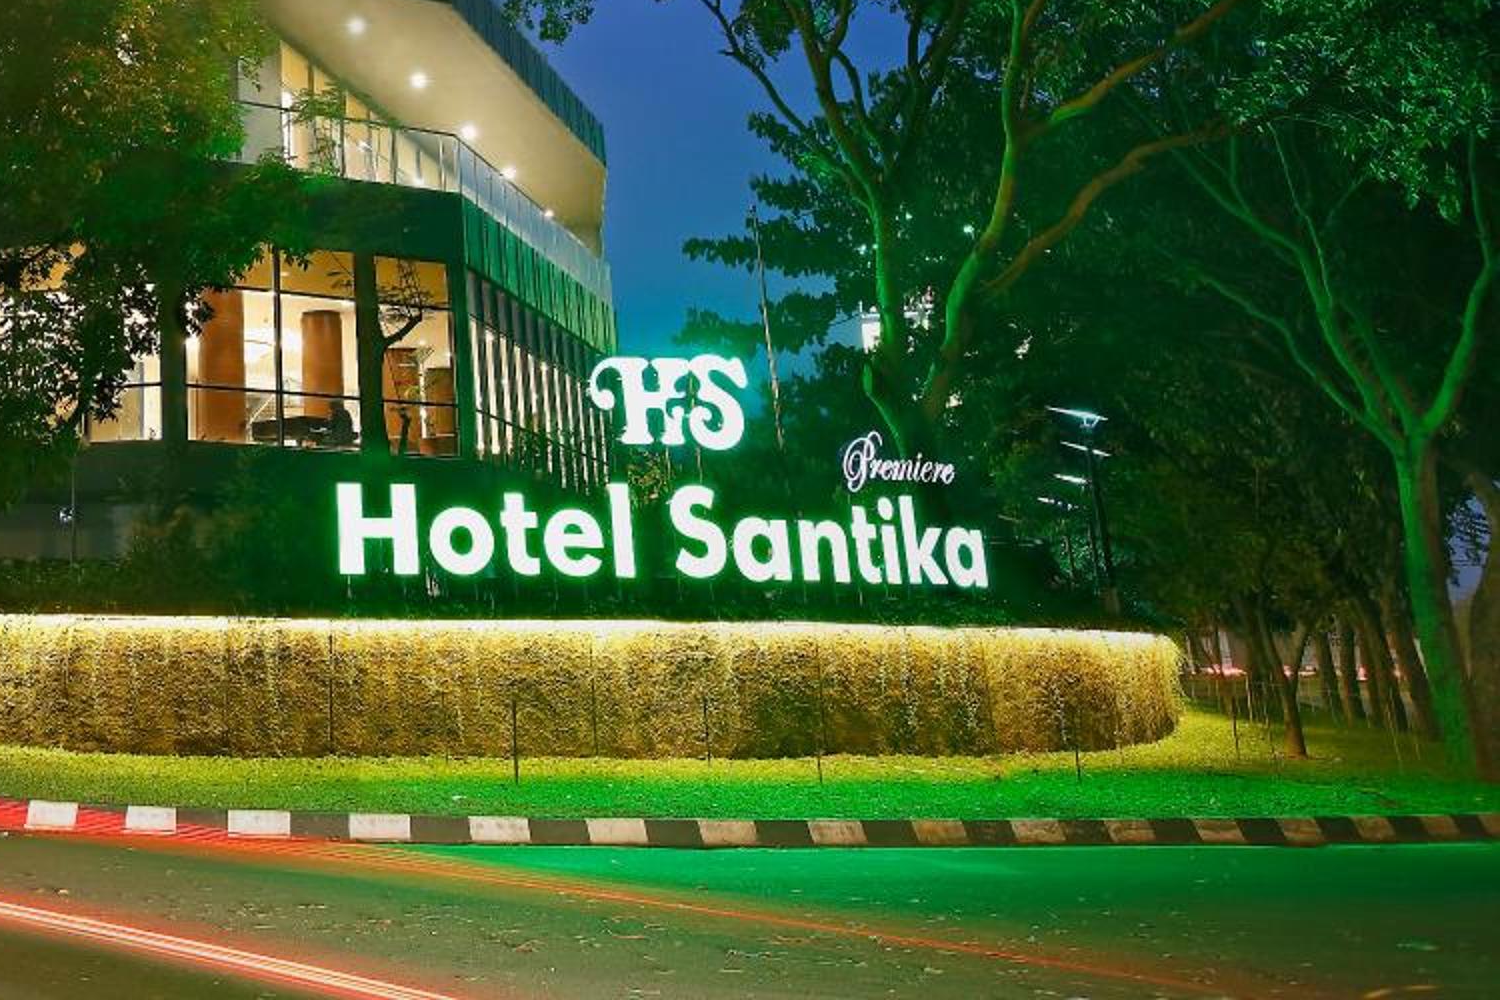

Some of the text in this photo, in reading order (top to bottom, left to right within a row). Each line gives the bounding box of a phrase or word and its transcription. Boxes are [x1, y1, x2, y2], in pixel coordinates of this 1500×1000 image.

[843, 431, 956, 491] Premiere
[335, 482, 989, 588] Hotel Santika
